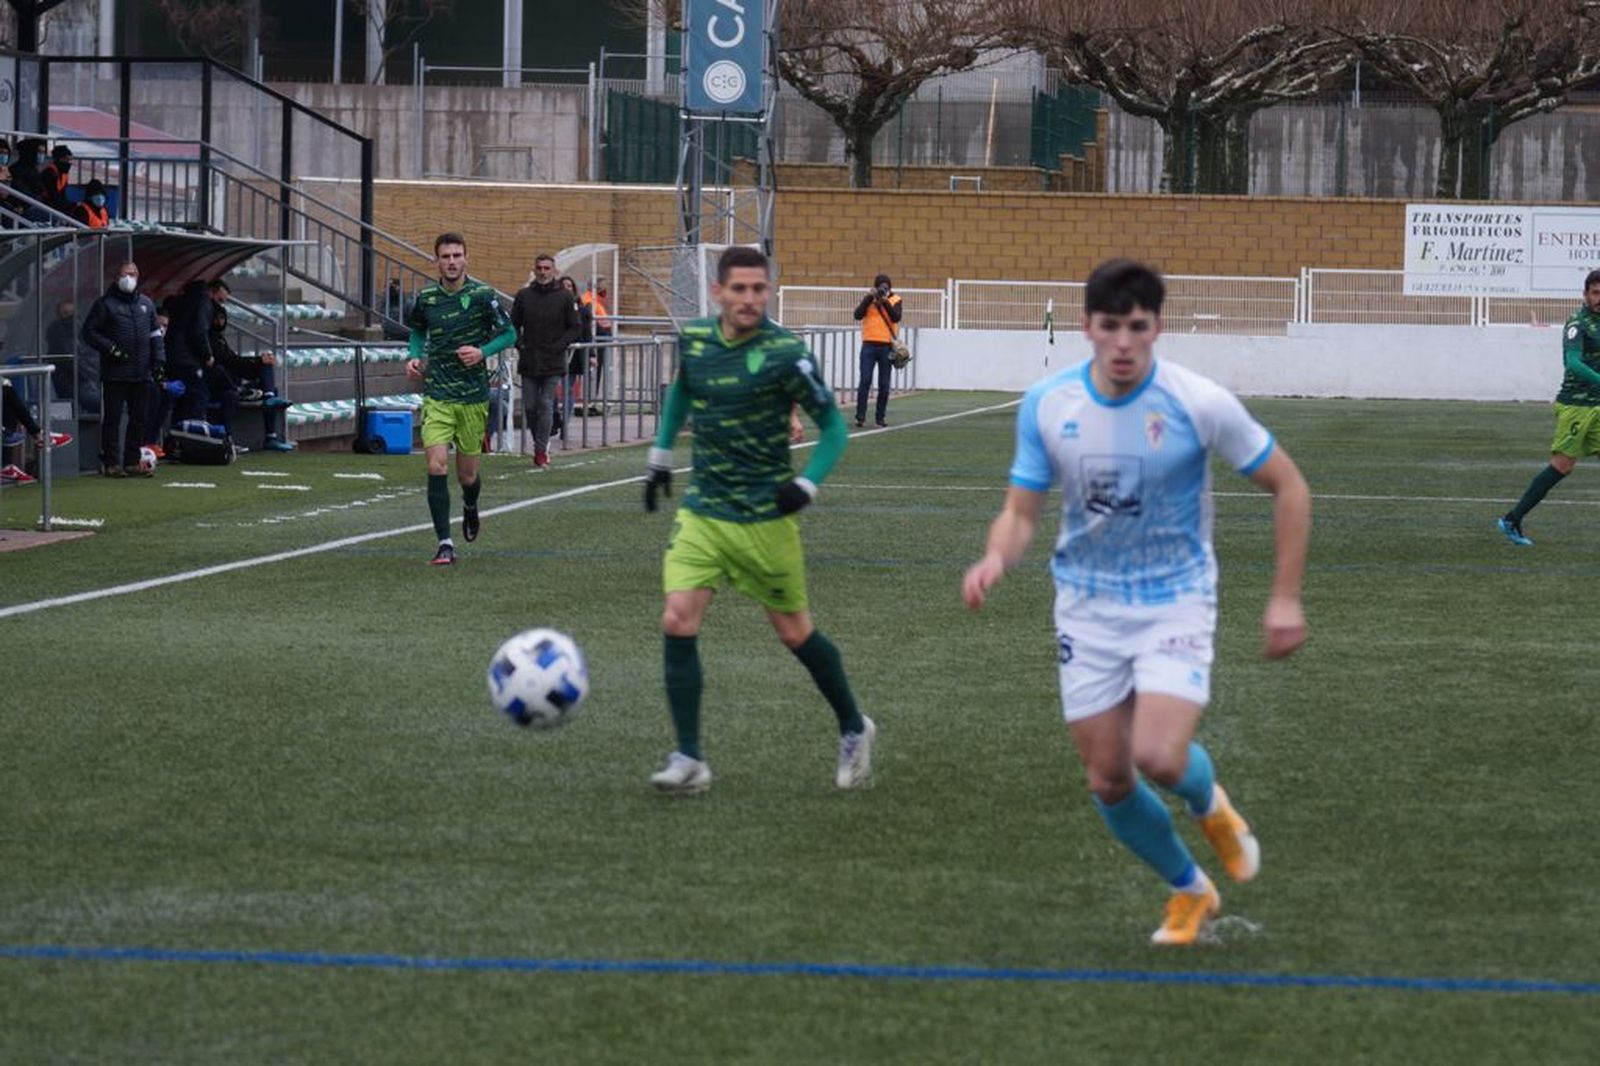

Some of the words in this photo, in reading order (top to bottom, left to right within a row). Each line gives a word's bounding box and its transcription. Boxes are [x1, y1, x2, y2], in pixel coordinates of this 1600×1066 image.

[1412, 212, 1524, 224] TRANSPORTES
[1420, 241, 1439, 261] F.
[1446, 241, 1524, 264] Martínez
[1569, 249, 1600, 260] HOT
[1570, 421, 1580, 437] 6
